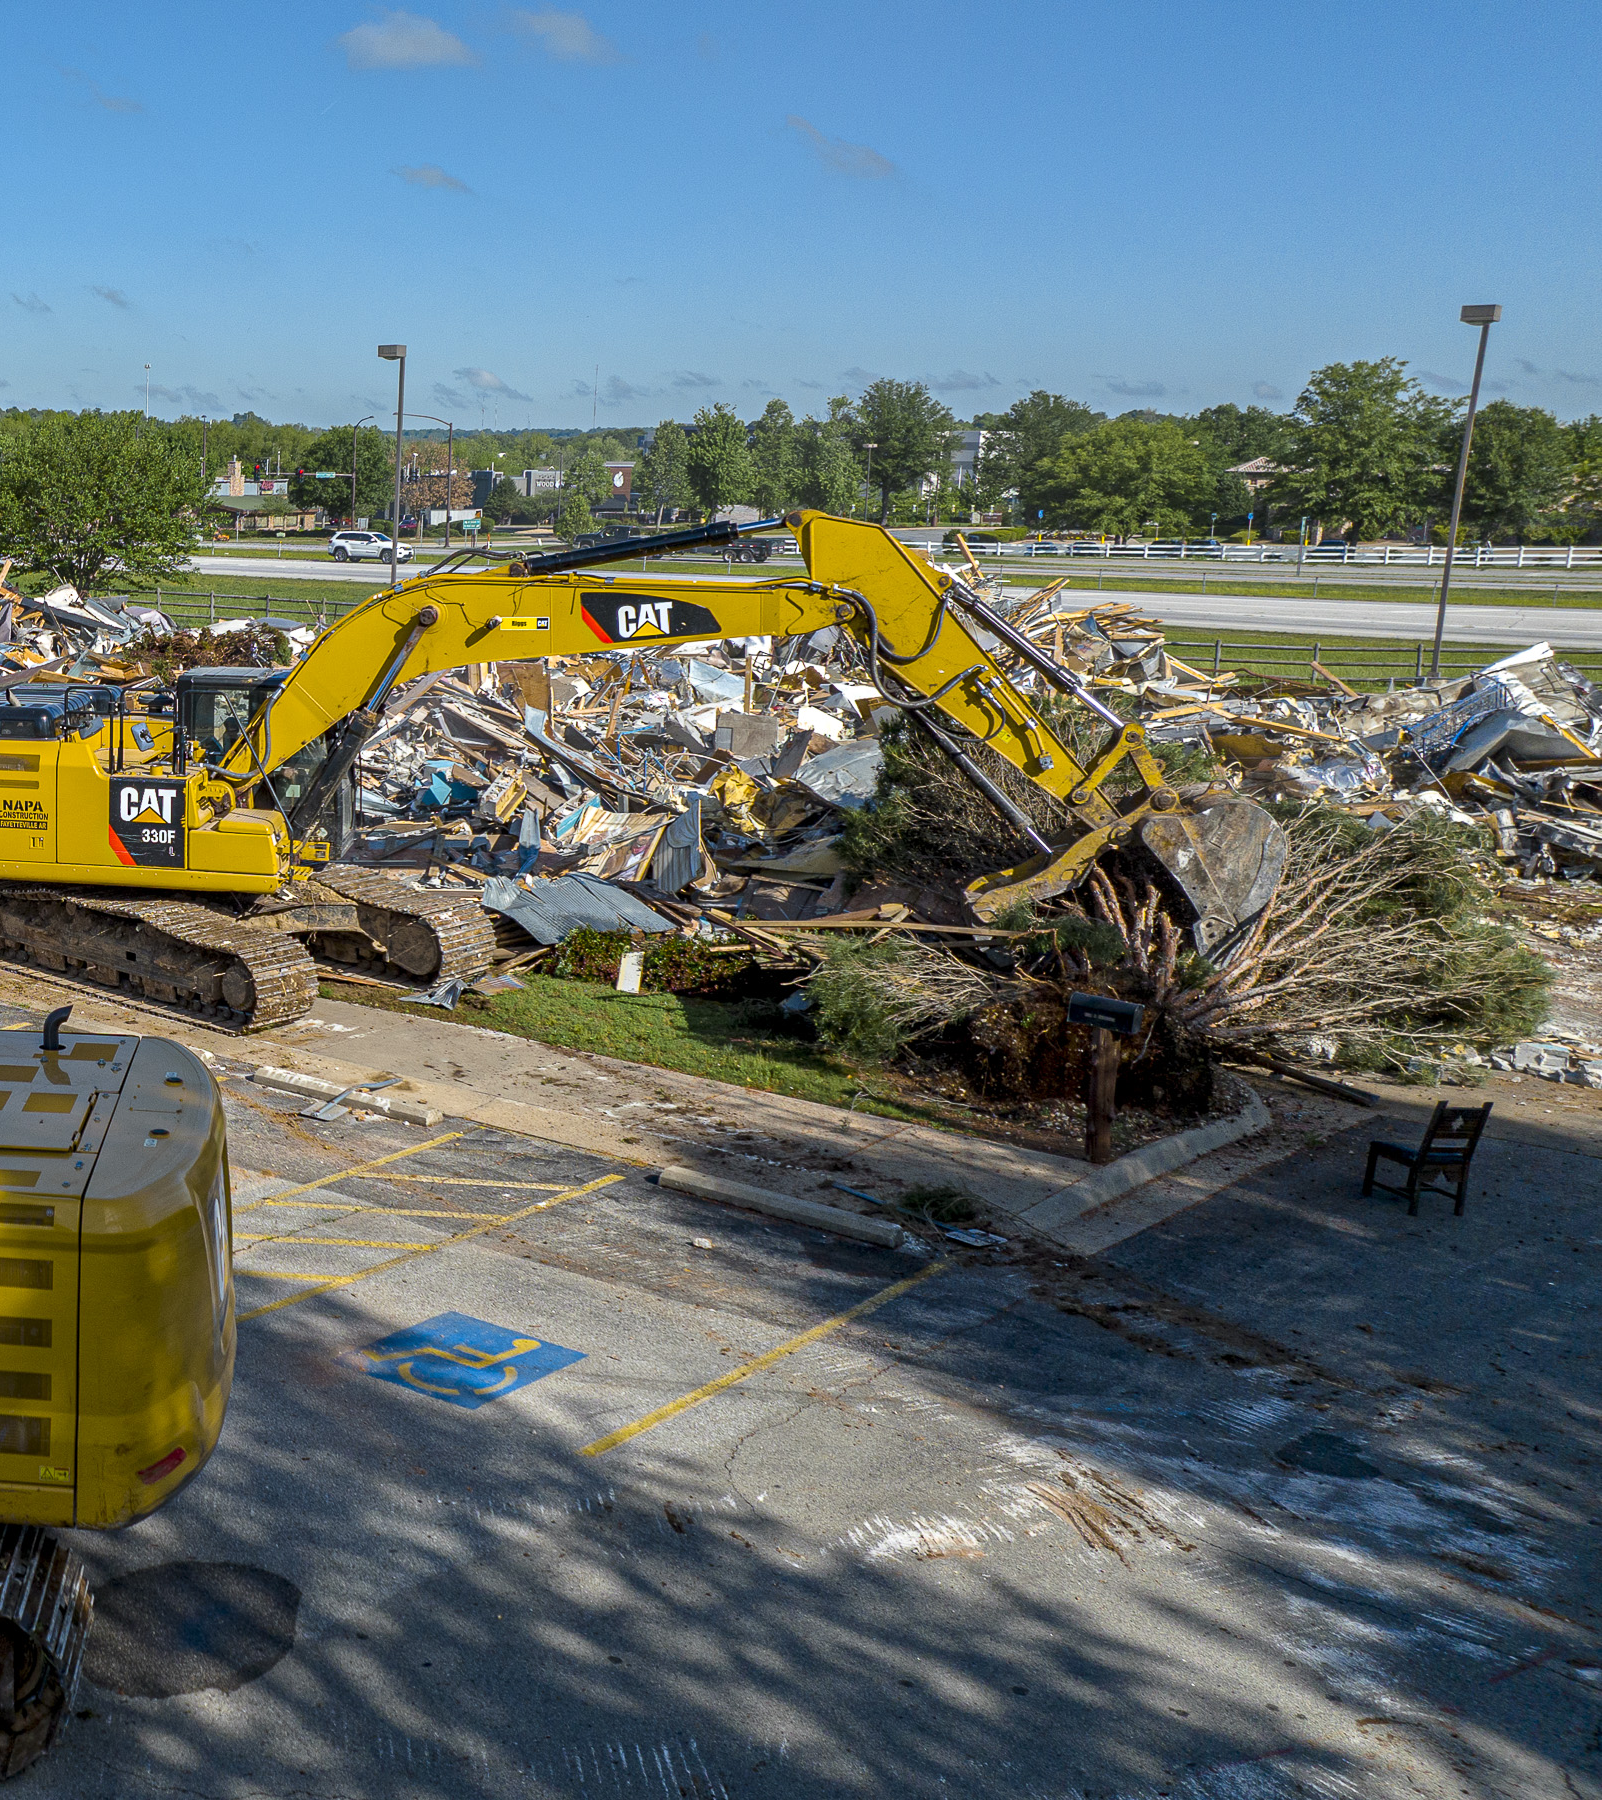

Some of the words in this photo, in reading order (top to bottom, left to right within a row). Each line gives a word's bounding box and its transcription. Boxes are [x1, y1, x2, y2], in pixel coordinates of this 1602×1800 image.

[537, 619, 548, 627] CAT
[618, 601, 673, 638] CAT
[3, 799, 44, 812] NAPA
[120, 786, 177, 824] CAT
[0, 820, 37, 828] FAYETTEVILLE
[142, 828, 176, 844] 330F
